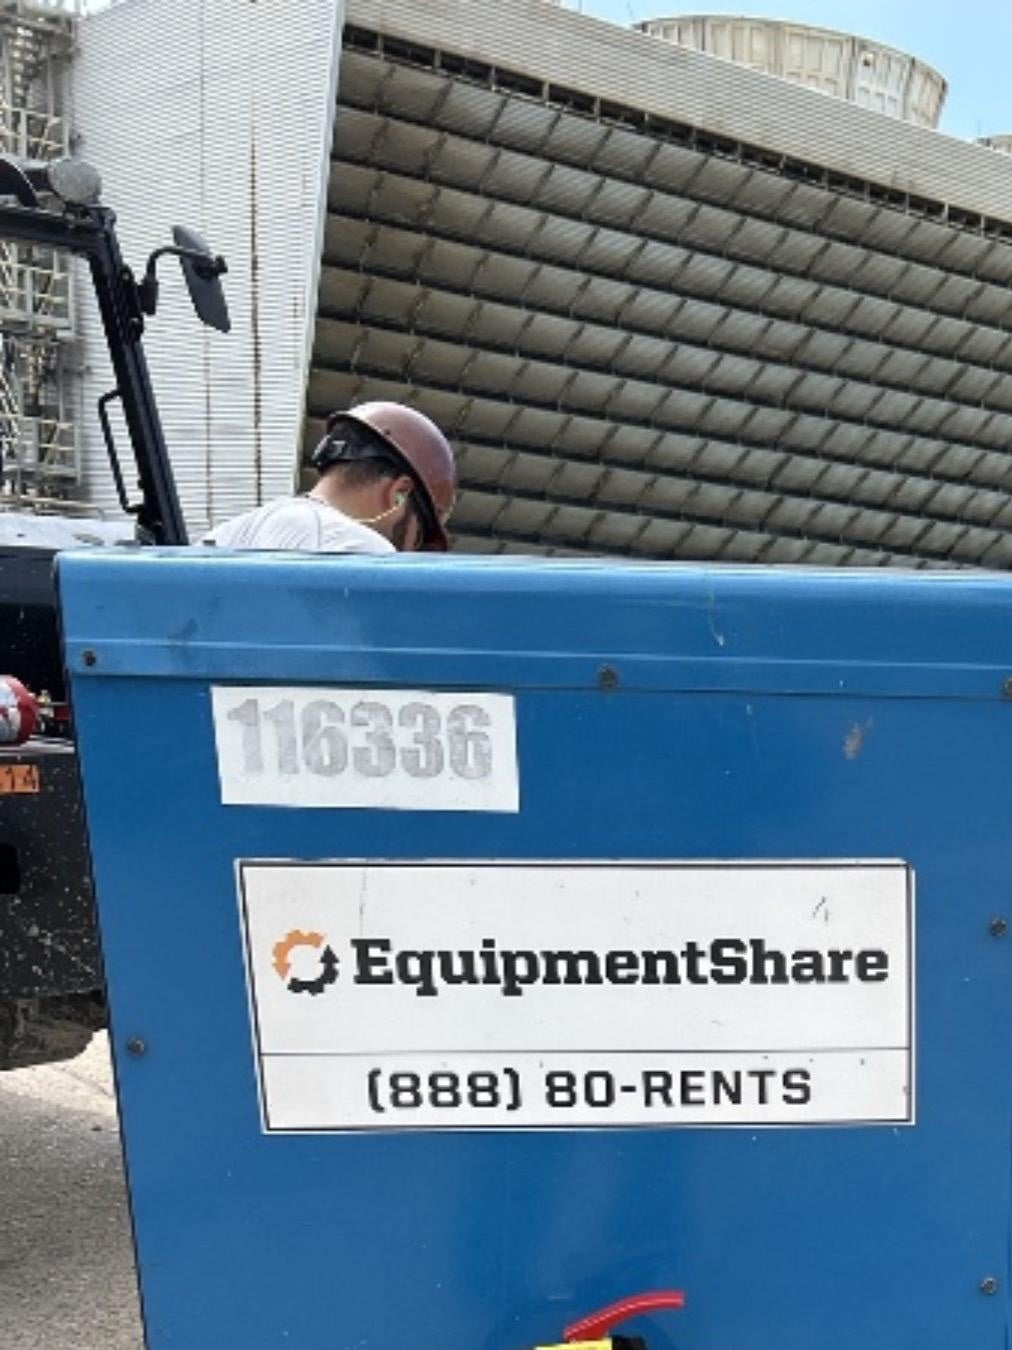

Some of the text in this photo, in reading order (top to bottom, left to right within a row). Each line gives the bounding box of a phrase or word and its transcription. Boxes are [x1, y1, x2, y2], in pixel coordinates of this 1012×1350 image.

[227, 698, 494, 780] 116336
[351, 938, 889, 996] EquipmentShare
[367, 1066, 812, 1112] (888) 80-RENTS
